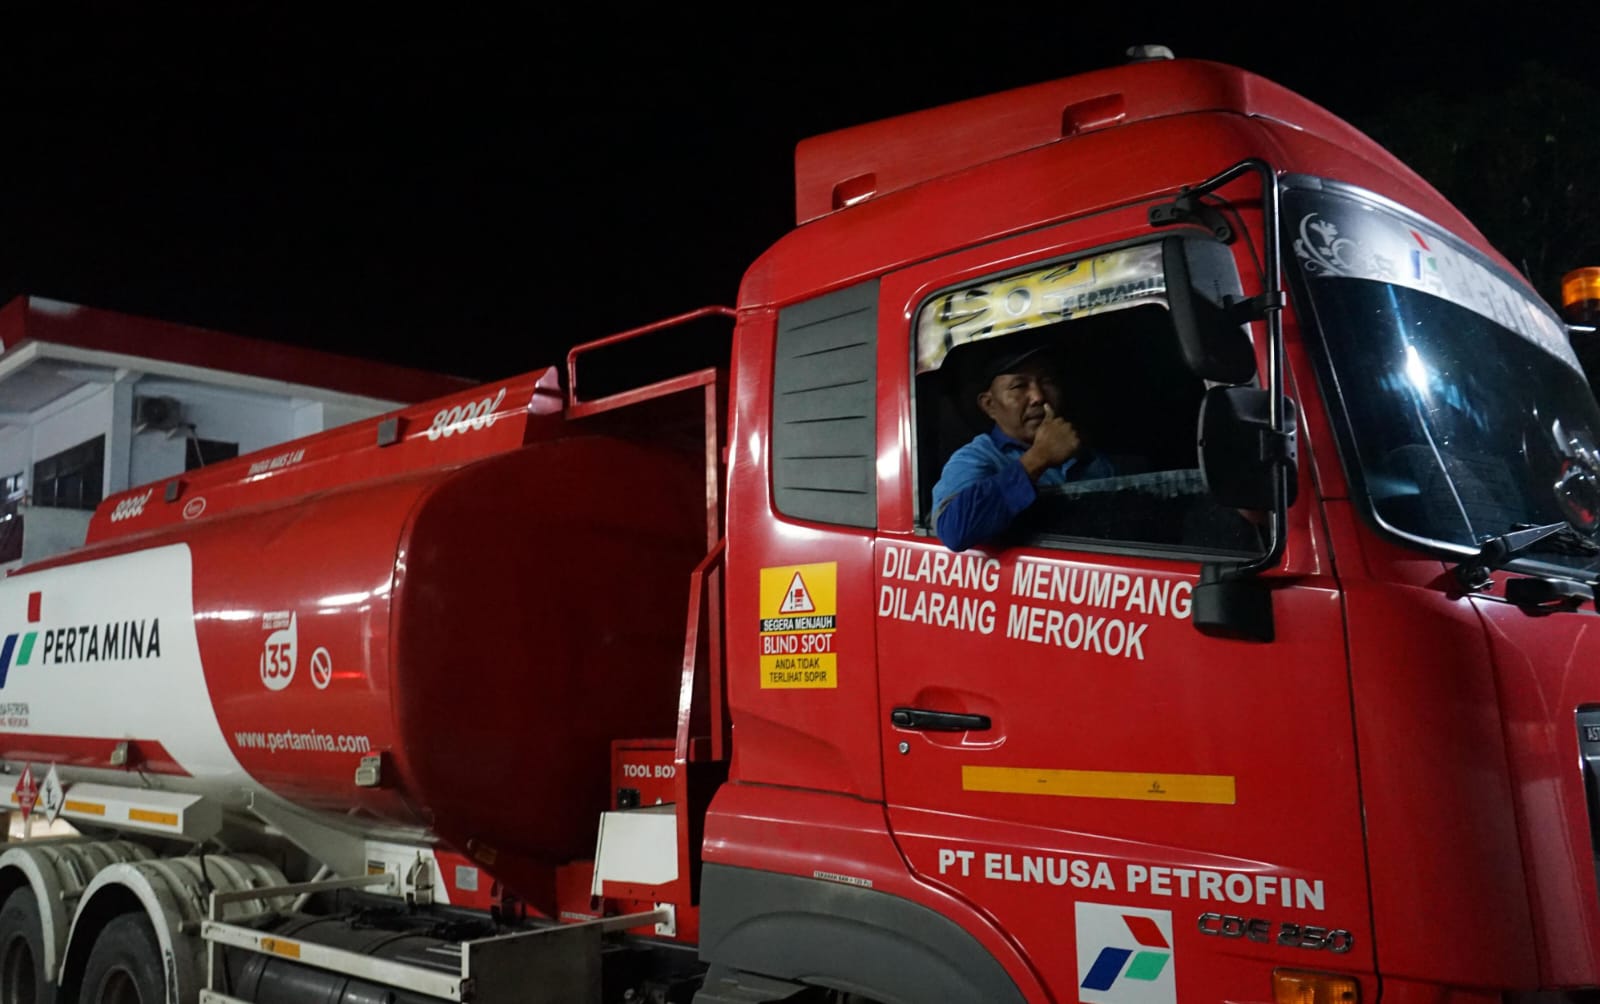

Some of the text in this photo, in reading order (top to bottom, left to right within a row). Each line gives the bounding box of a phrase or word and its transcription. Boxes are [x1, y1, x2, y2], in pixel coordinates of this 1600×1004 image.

[881, 546, 1194, 619] DILARANG MENUMPANG
[763, 615, 833, 632] SEGERA MENJAUH
[878, 585, 1149, 660] DILARANG MEROKOK
[42, 617, 161, 665] PERTAMINA
[763, 633, 832, 655] BLIND SPOT
[775, 657, 820, 670] ANDA TIDAK
[769, 670, 827, 683] TERLIHAT SOPIR
[234, 729, 370, 753] www.pertamina.com
[623, 764, 652, 778] TOOL
[938, 848, 1326, 911] PT ELNUSA PETROFIN
[1197, 911, 1354, 954] CDE 250
